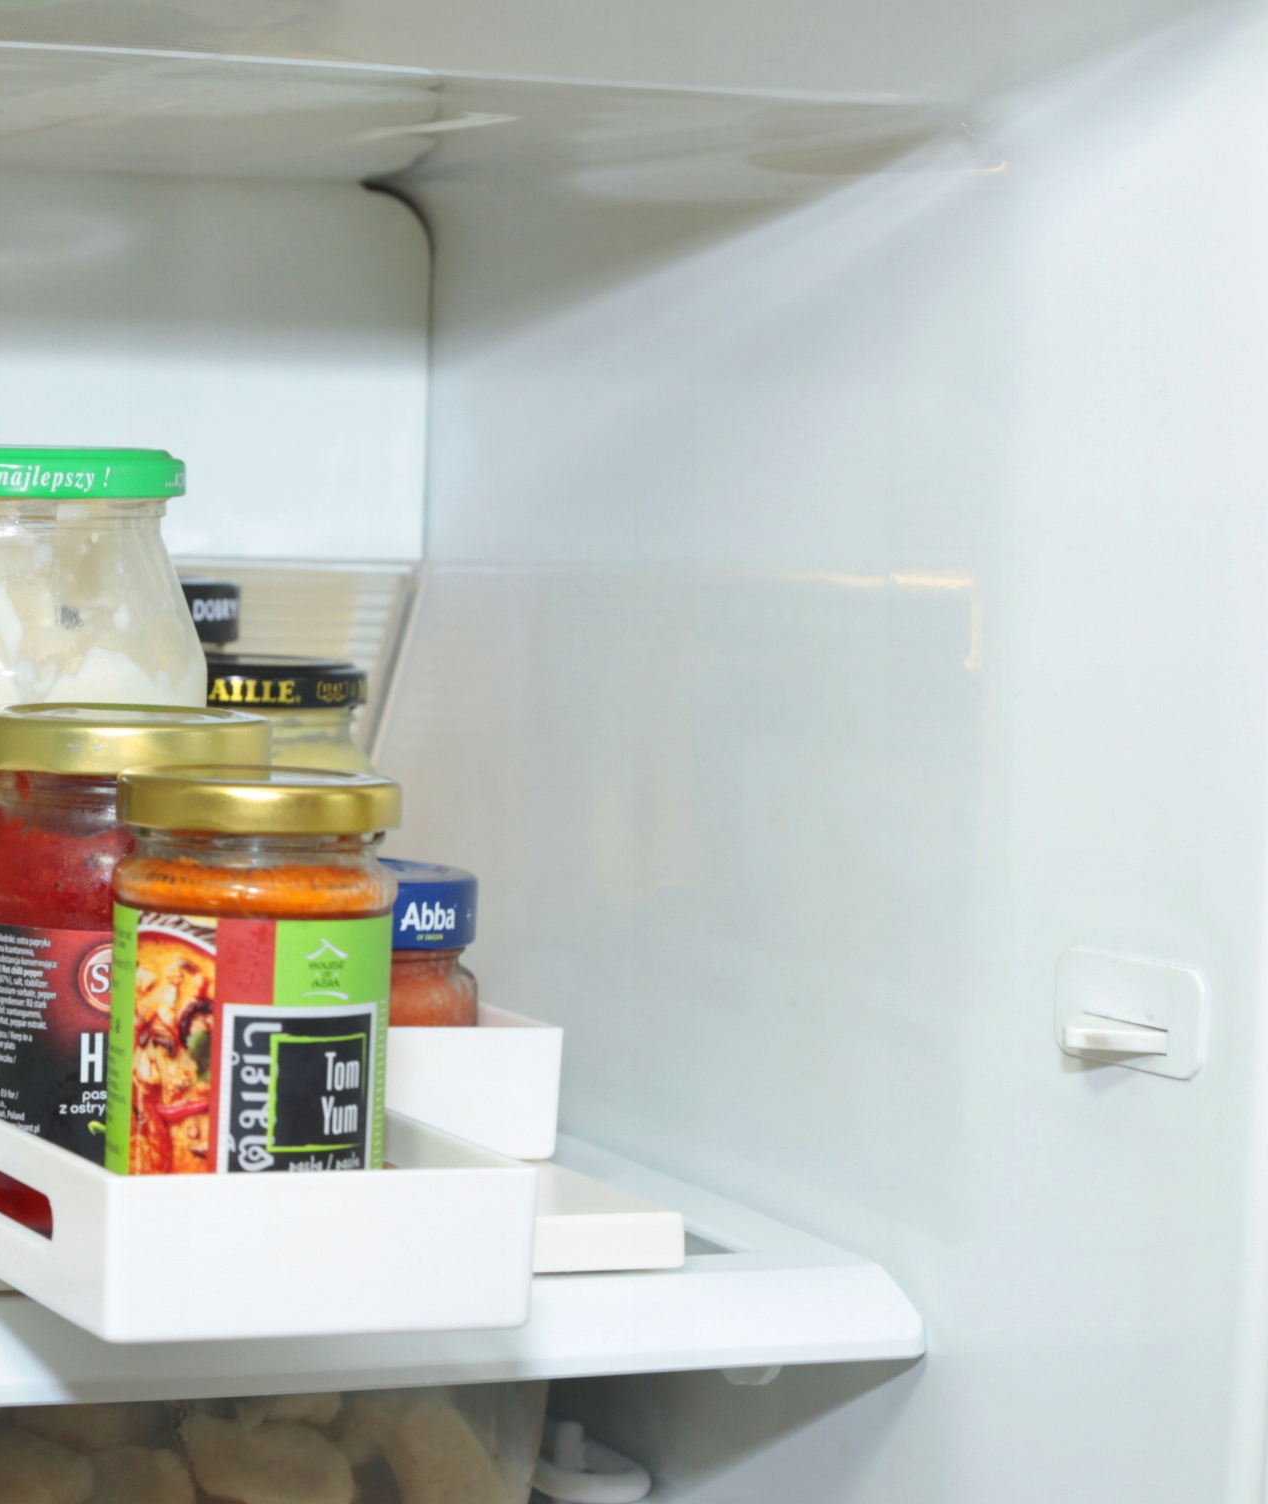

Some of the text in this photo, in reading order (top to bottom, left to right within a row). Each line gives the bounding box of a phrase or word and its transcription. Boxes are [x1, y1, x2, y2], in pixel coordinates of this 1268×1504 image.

[208, 679, 295, 703] AILLE
[400, 900, 456, 932] Abba
[28, 937, 51, 948] papryka
[23, 968, 43, 978] pepper
[90, 963, 111, 994] S
[37, 990, 56, 1000] pepper
[79, 1032, 105, 1084] H
[324, 1050, 361, 1092] Tom
[81, 1089, 108, 1103] pas
[6, 1109, 25, 1121] Poland
[58, 1101, 107, 1117] z ostry
[320, 1095, 359, 1137] Yum
